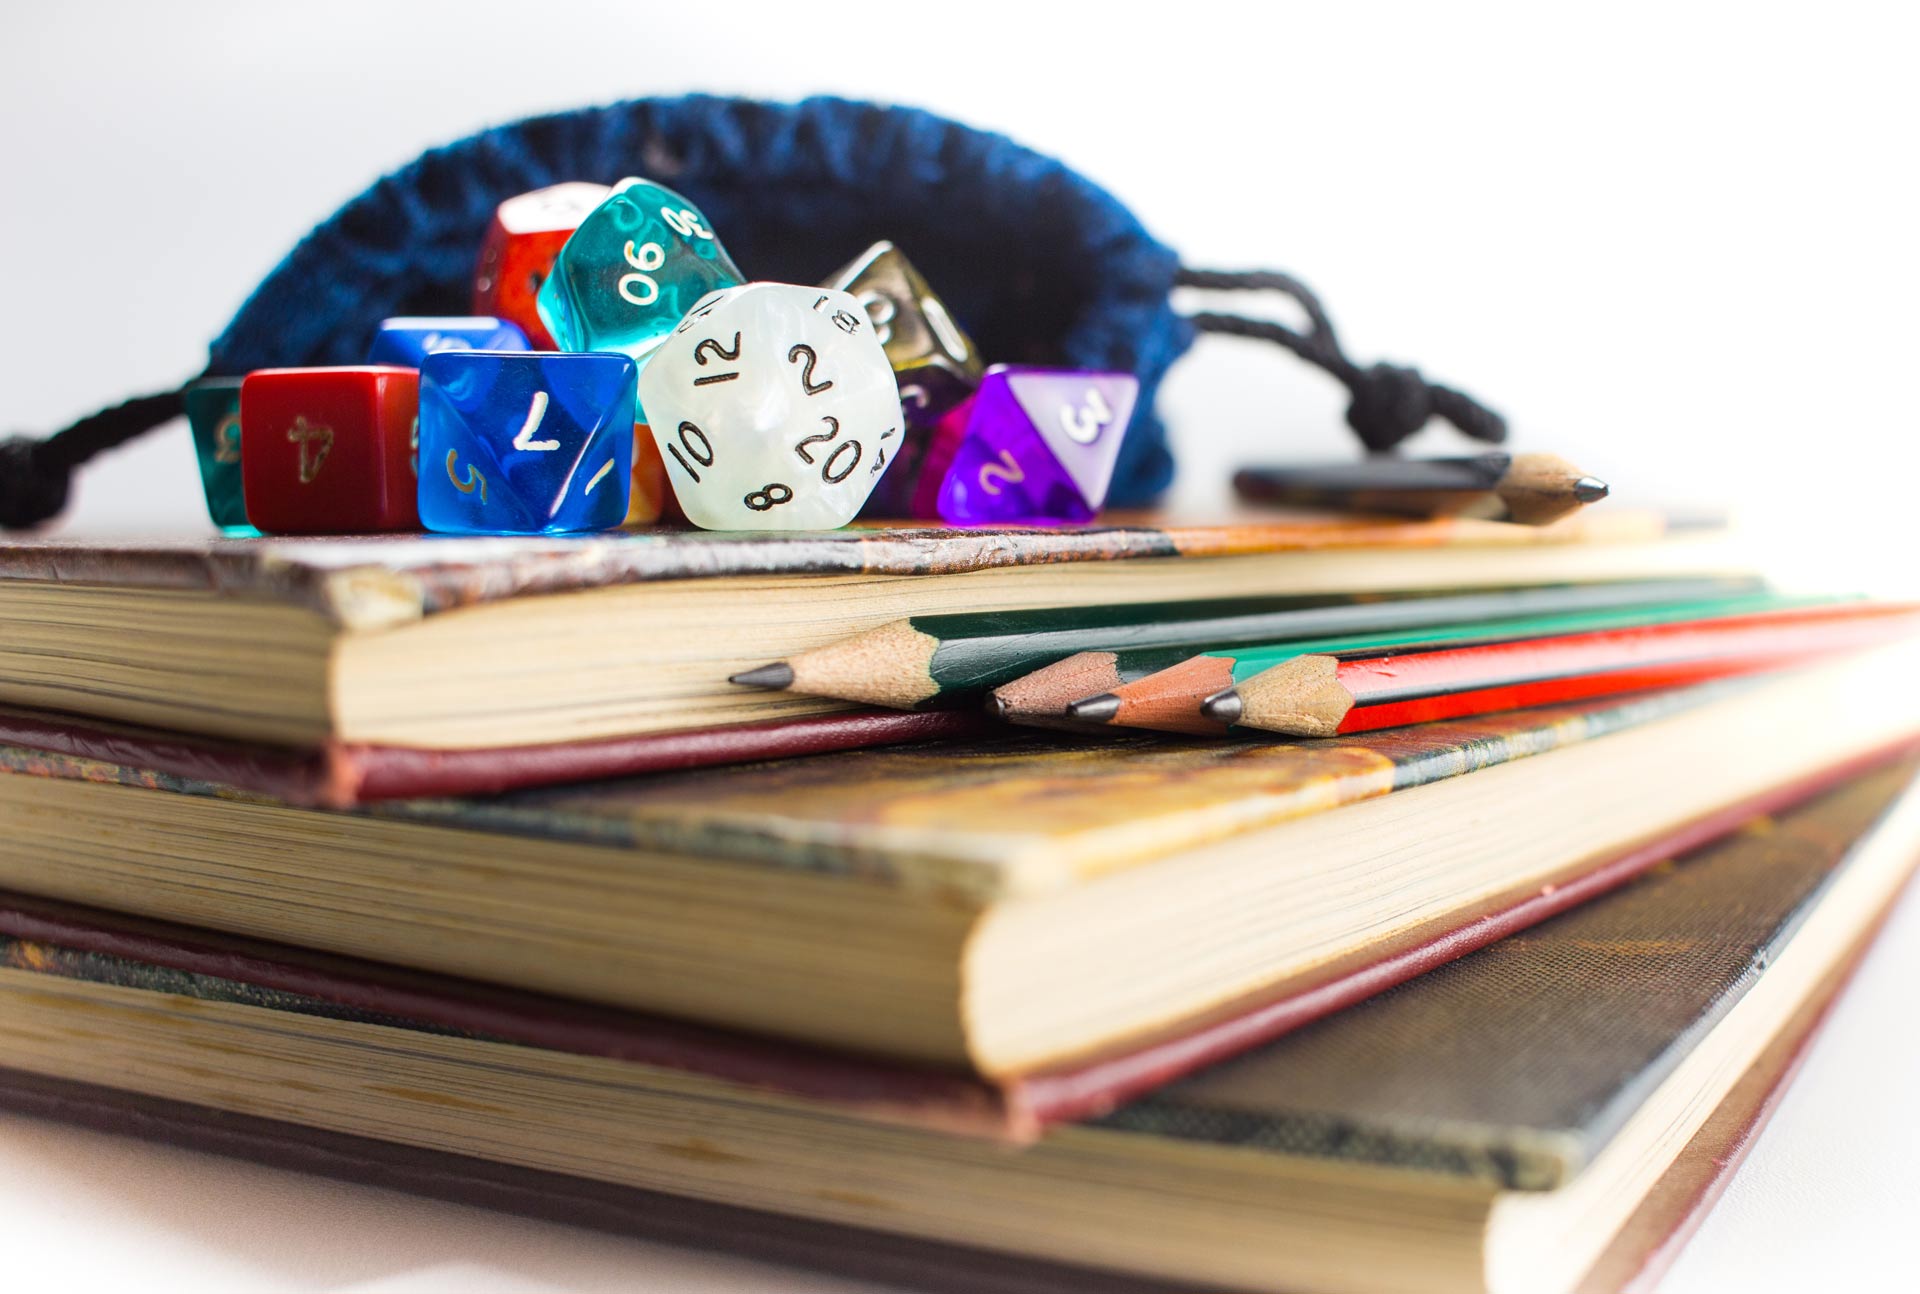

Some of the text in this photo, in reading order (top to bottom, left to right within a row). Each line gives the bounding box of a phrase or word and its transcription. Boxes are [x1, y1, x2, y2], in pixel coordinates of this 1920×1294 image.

[618, 240, 665, 305] 90
[693, 331, 741, 386] 12
[788, 344, 833, 396] 2
[1060, 387, 1113, 446] 3
[287, 415, 335, 484] 4
[446, 447, 488, 506] 5
[667, 421, 714, 484] 10
[794, 416, 861, 484] 20
[979, 448, 1025, 496] 2
[743, 483, 794, 511] 8
